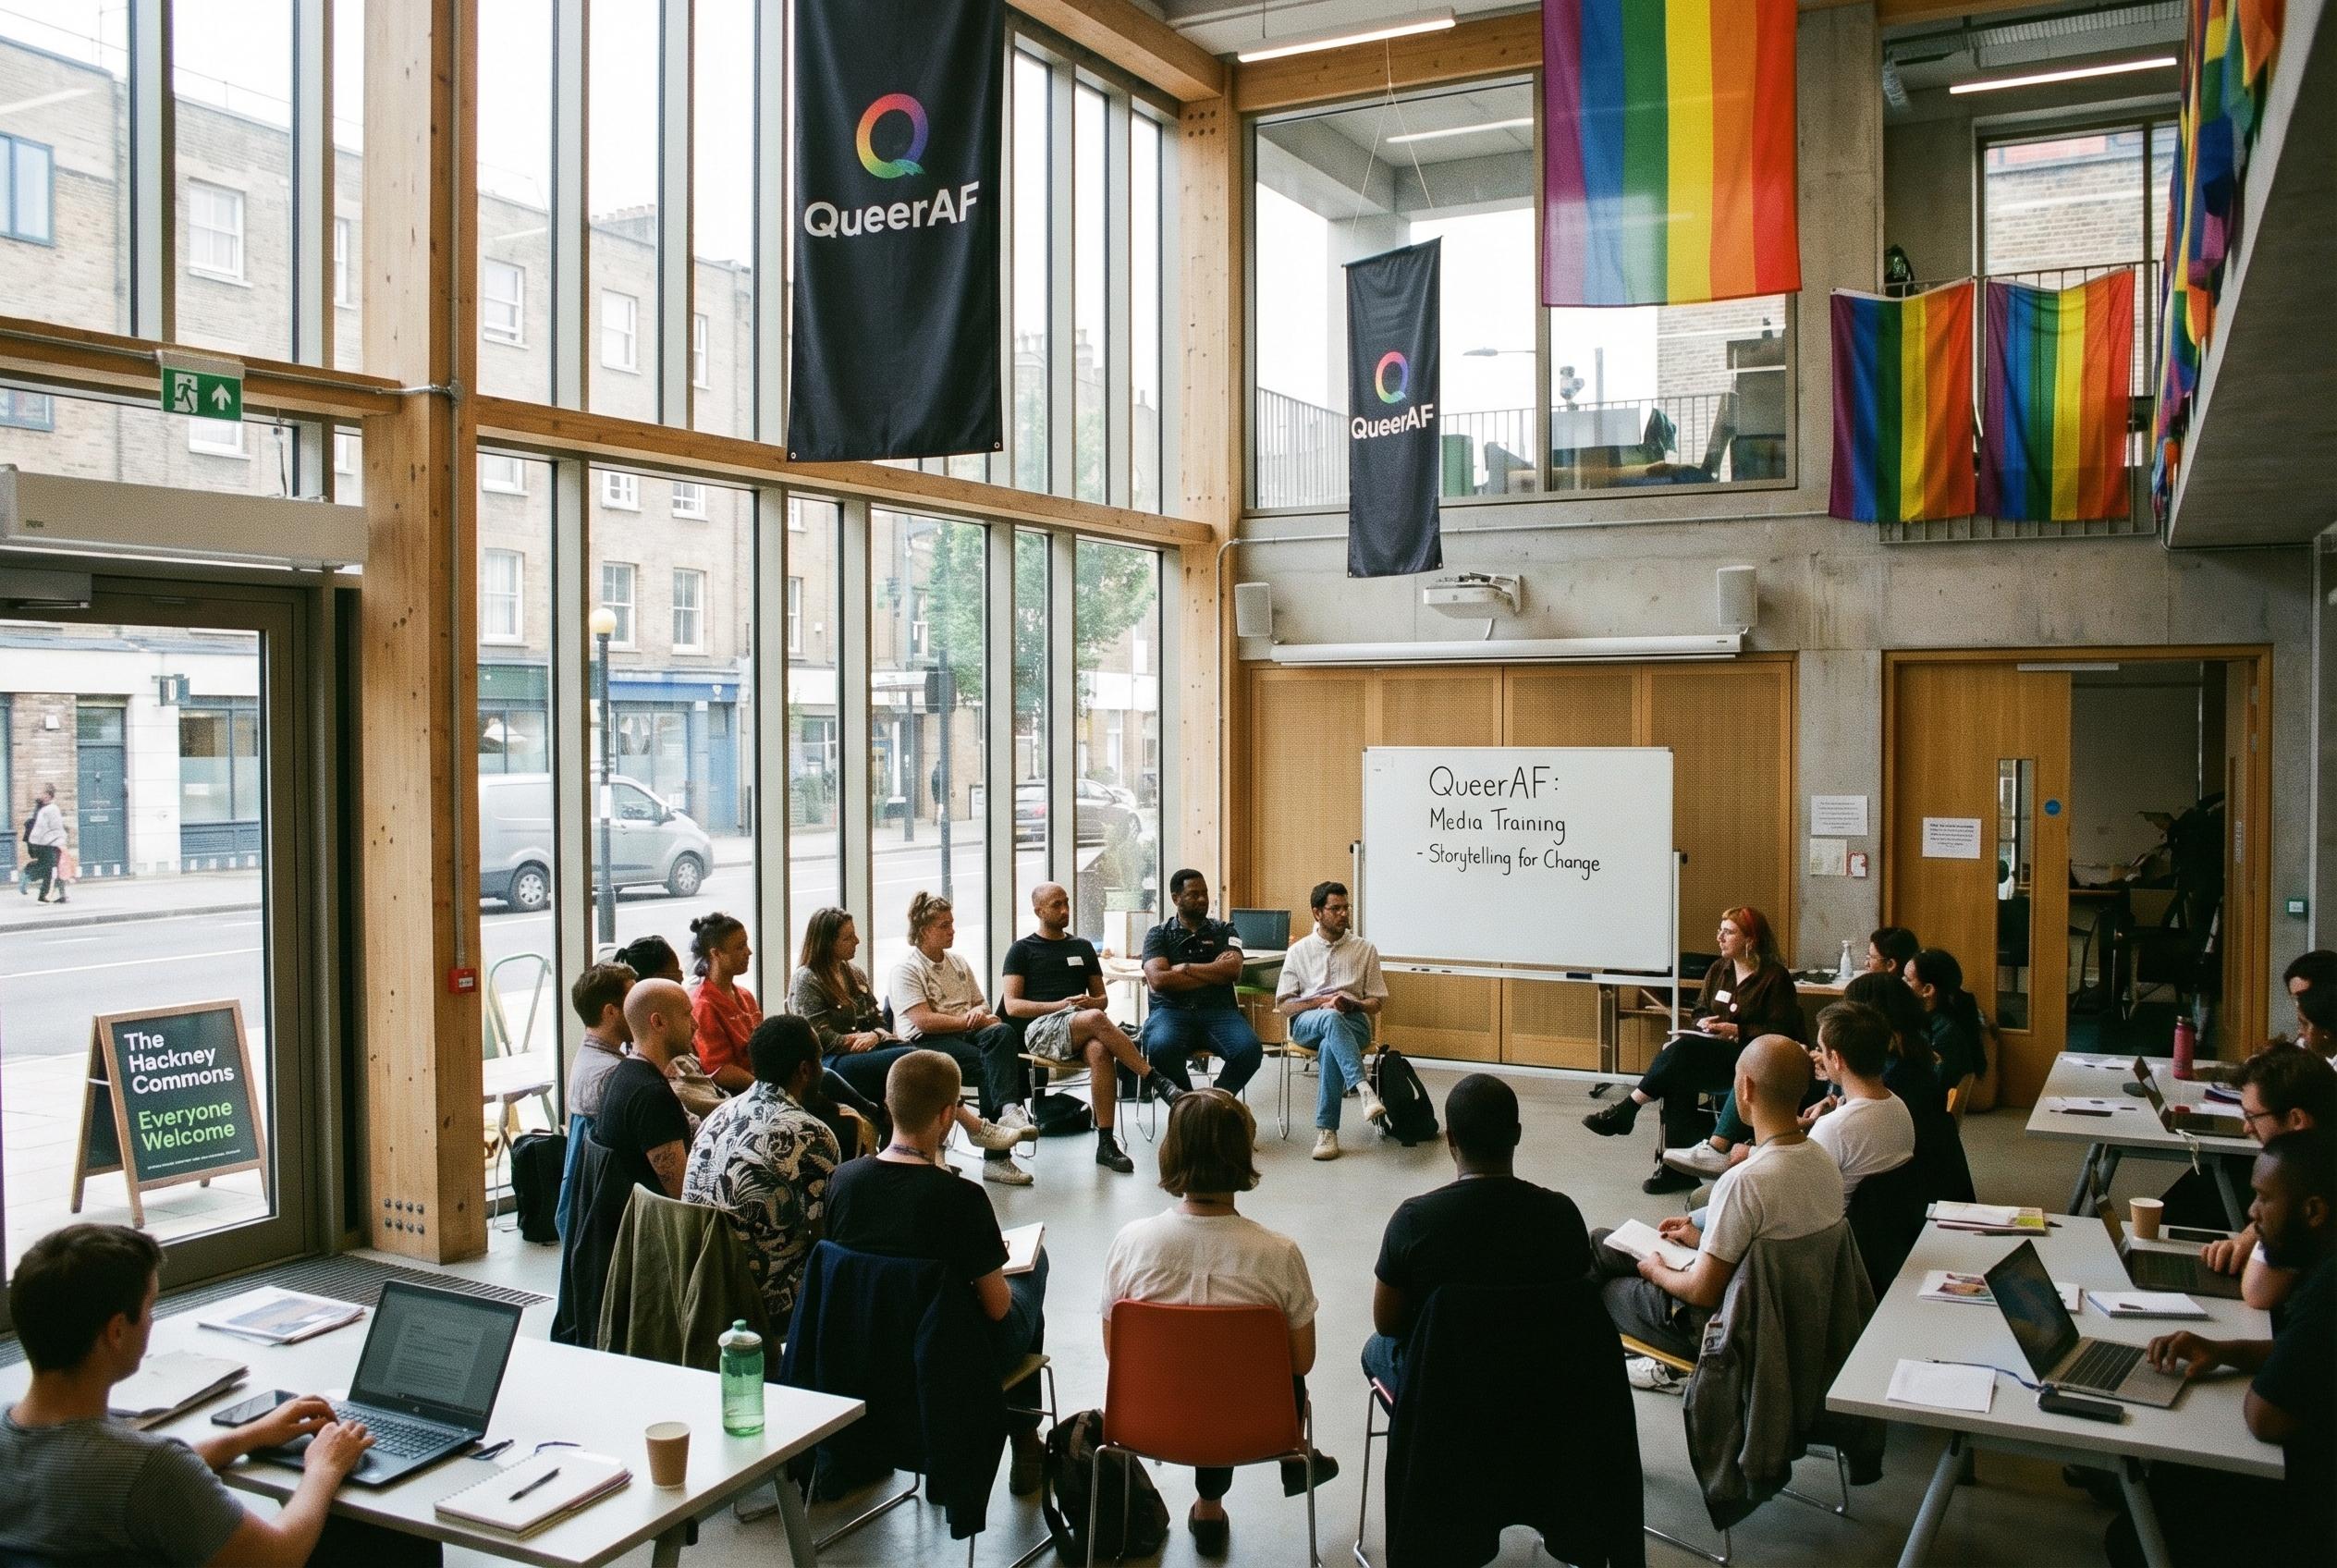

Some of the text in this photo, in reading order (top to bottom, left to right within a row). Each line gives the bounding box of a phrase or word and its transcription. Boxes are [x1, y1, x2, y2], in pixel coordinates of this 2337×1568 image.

[804, 181, 979, 238] QueerAF
[1352, 403, 1433, 439] QueerAF
[1429, 766, 1559, 799] QueerAF:
[1430, 807, 1565, 845] Media Training
[1429, 843, 1511, 875] Storytelling
[1518, 847, 1538, 867] for
[1544, 849, 1600, 880] Change
[124, 1032, 164, 1051] The
[128, 1047, 215, 1072] Hackney
[132, 1067, 234, 1094] Commons
[139, 1102, 232, 1130] Everyone
[141, 1123, 235, 1151] Welcome
